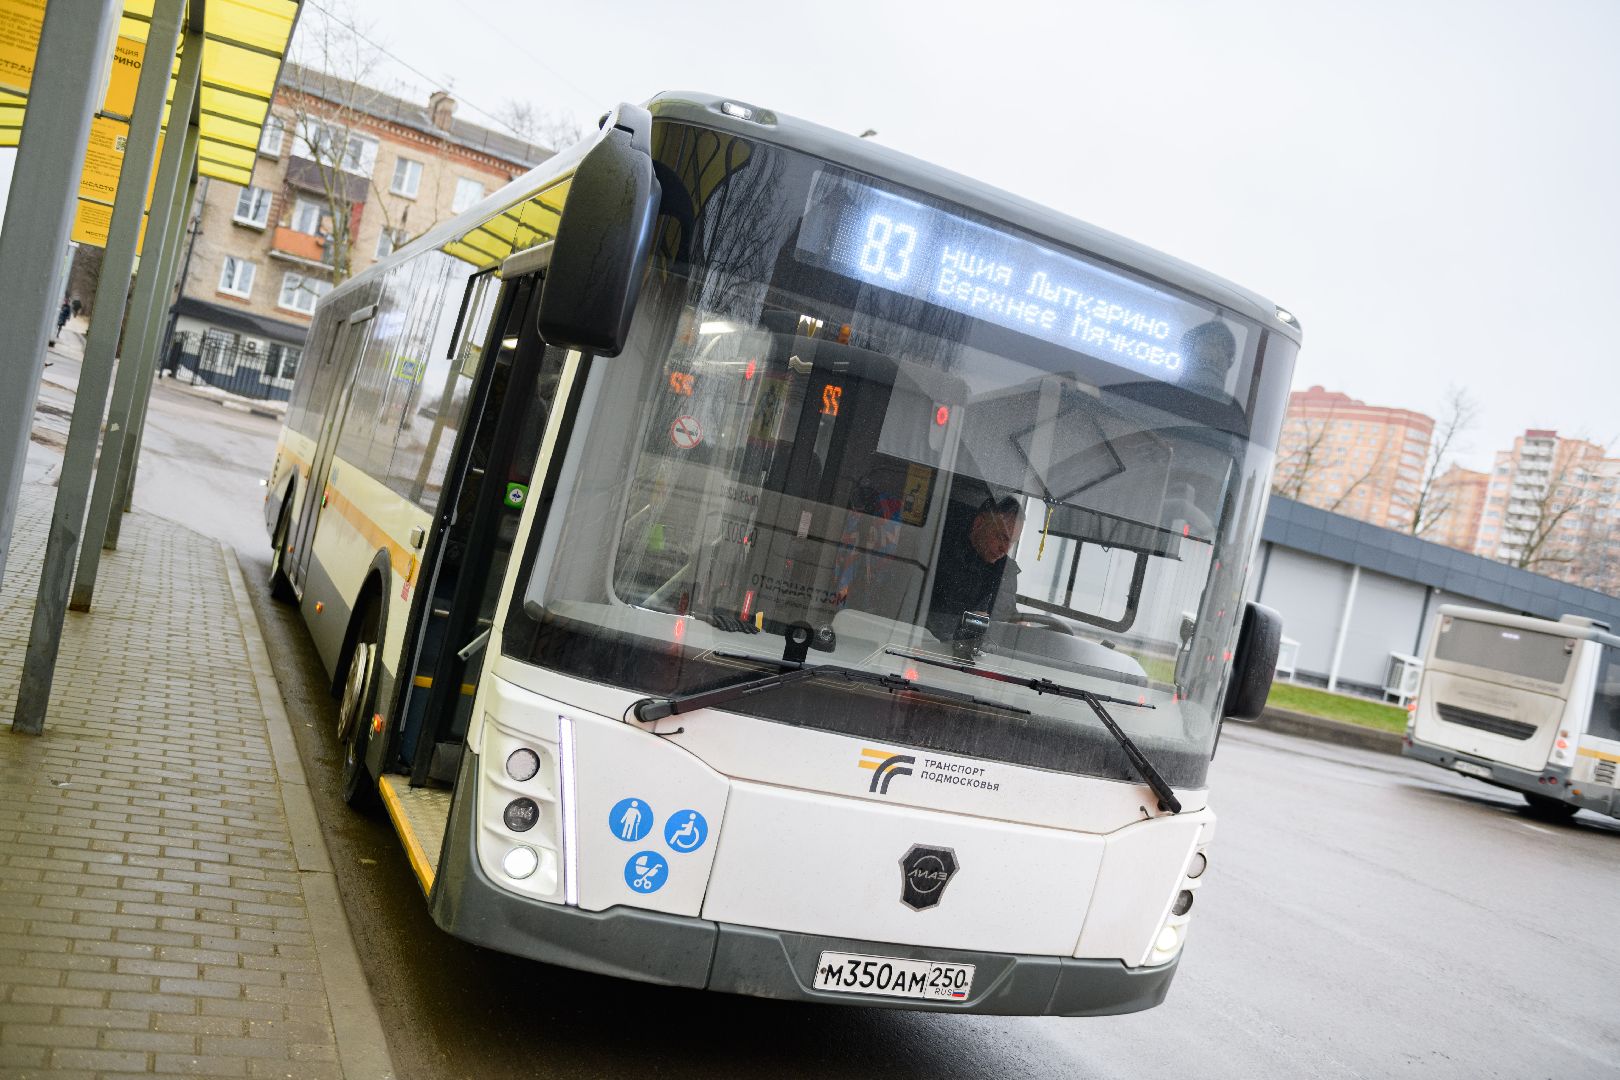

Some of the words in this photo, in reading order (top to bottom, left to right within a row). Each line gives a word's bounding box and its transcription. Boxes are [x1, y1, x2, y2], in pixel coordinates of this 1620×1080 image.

[114, 54, 141, 69] РИНО
[115, 46, 139, 58] НЦИЯ
[858, 213, 918, 282] 83
[1025, 271, 1170, 341] Лыткарино
[937, 267, 1057, 330] Верхнее
[1070, 313, 1183, 371] Мячково
[924, 759, 985, 777] ТРАНСПОРТ
[920, 770, 1000, 792] ПОДМОСКОВЬЯ
[823, 959, 927, 993] М350АМ
[929, 967, 966, 989] 250
[934, 987, 952, 996] RUS
